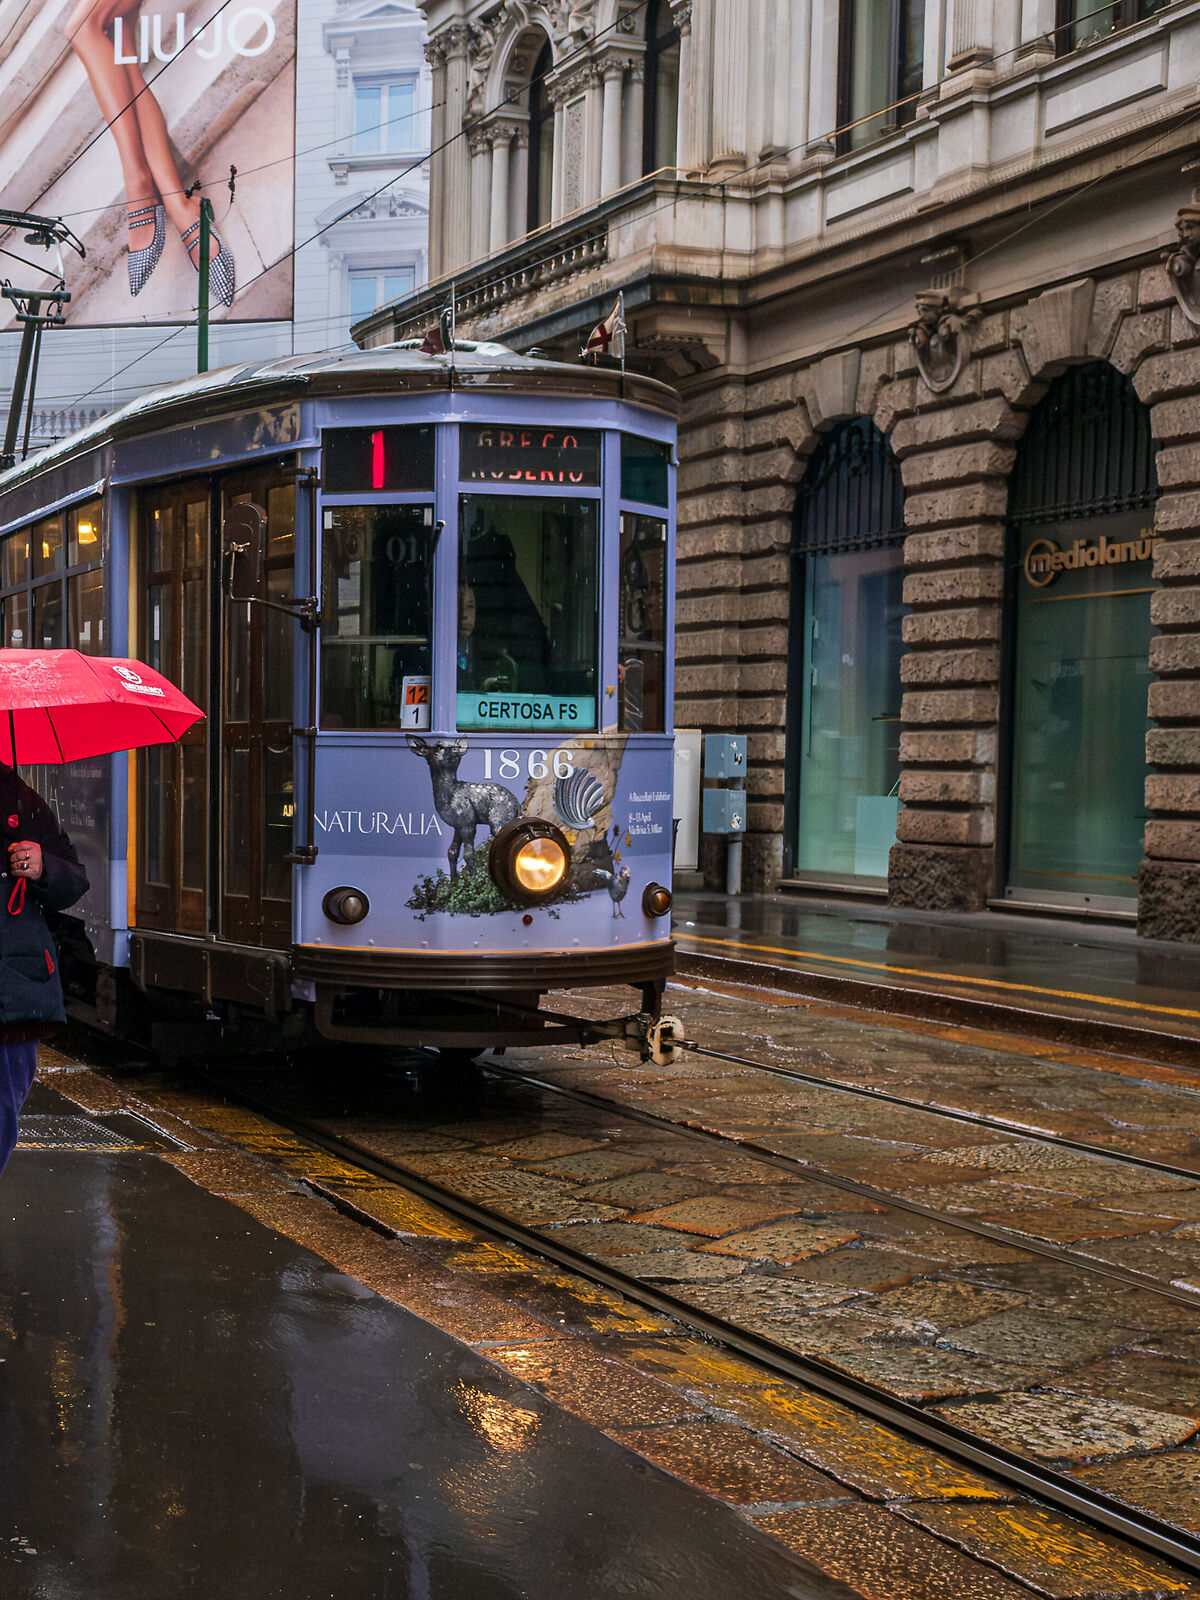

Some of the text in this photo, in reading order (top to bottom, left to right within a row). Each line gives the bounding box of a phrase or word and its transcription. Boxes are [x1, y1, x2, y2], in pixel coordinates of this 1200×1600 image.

[372, 430, 385, 488] 1
[408, 686, 428, 704] 12
[412, 707, 420, 724] 1
[478, 701, 578, 719] CERTOSA FS
[483, 749, 574, 780] 1866
[314, 810, 443, 836] NATURALIA
